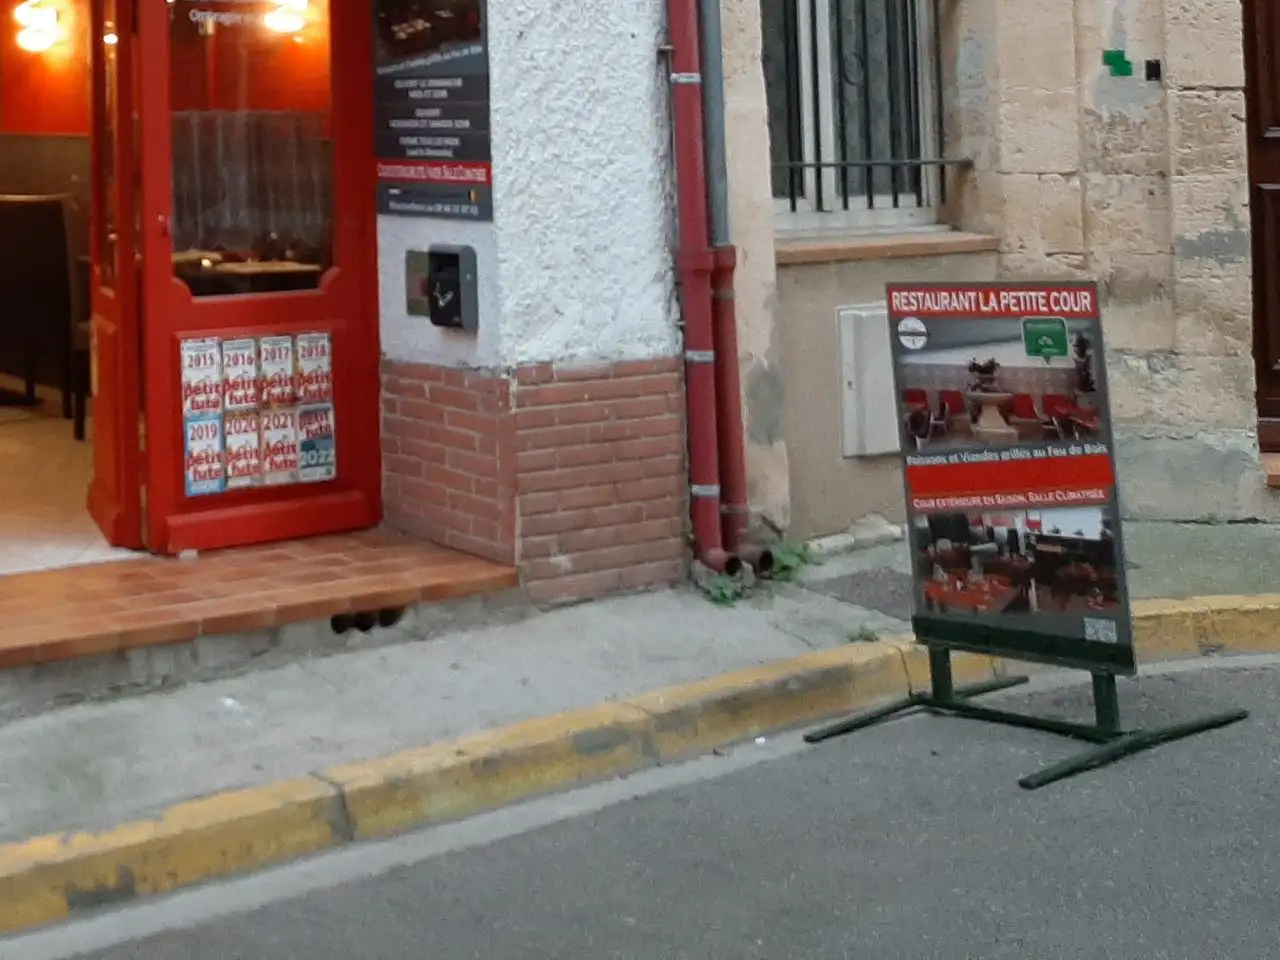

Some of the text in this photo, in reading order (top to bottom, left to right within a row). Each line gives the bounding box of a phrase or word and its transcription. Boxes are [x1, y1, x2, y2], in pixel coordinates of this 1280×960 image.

[892, 290, 1092, 313] RESTAURANT LA PETITE COUR
